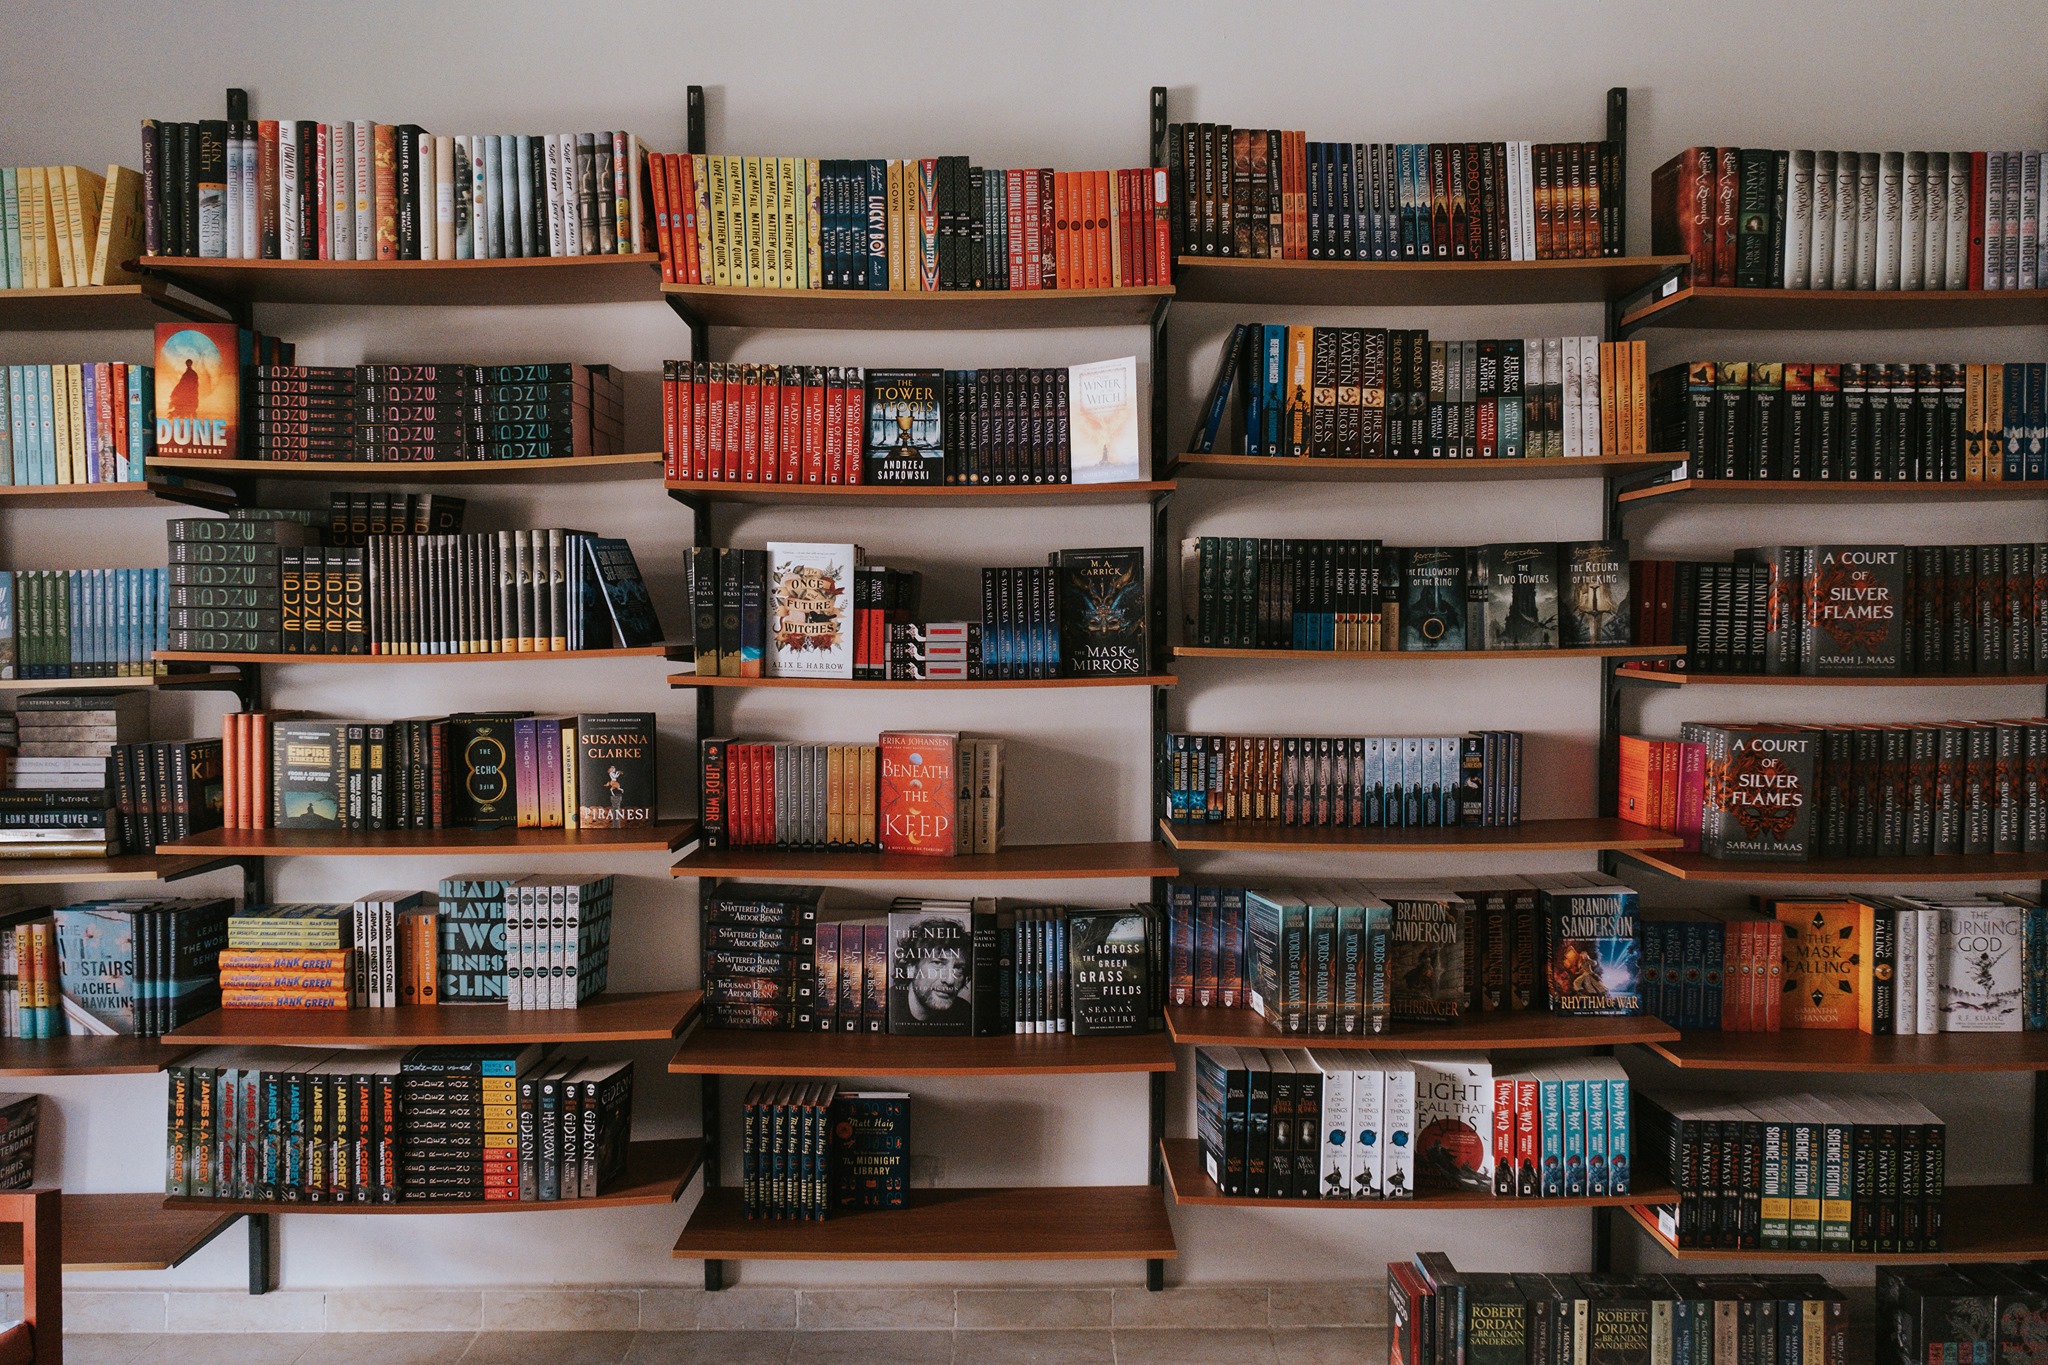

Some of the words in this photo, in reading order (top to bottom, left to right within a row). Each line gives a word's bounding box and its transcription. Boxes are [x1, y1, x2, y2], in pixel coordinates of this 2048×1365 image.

[335, 127, 343, 153] JUDY
[713, 160, 721, 176] LOVE
[335, 156, 344, 195] BLUME
[1990, 156, 2001, 194] CHARLIE
[869, 196, 885, 229] LUCKY
[1989, 196, 2000, 221] JANE
[718, 210, 726, 245] MATTHEW
[869, 233, 886, 258] BOY
[716, 246, 726, 267] QUICK
[1988, 236, 2000, 274] ANDERS
[1317, 334, 1329, 387] MARTIN
[897, 379, 913, 387] THE
[875, 387, 934, 401] TOWER
[55, 379, 65, 423] NICHOLAS
[888, 401, 933, 413] FOOLS
[1314, 409, 1323, 443] BLOOD
[1324, 409, 1333, 430] FIRE
[156, 418, 227, 446] DUNE
[883, 461, 924, 470] ANDRZEJ
[877, 471, 929, 480] SAPKOWSKI
[1822, 553, 1835, 565] A
[1841, 552, 1898, 565] COURT
[1080, 567, 1122, 576] CARRICK
[1405, 568, 1416, 576] THE
[1417, 567, 1460, 576] FELLOWSHIP
[1518, 564, 1529, 572] THE
[1570, 564, 1583, 572] THE
[1585, 562, 1619, 572] RETURN
[1434, 577, 1452, 586] RING
[1497, 574, 1516, 584] TWO
[1518, 574, 1549, 584] TOWERS
[1596, 574, 1617, 584] KING
[1851, 572, 1867, 581] OF
[792, 579, 823, 589] ONCE
[1700, 581, 1713, 616] NINTH
[1830, 588, 1888, 601] SILVER
[787, 600, 831, 610] FUTURE
[1824, 606, 1893, 619] FLAMES
[785, 623, 834, 633] WITCHES
[1697, 620, 1711, 655] HOUSE
[1086, 645, 1127, 658] MASK
[1072, 658, 1140, 672] MIRRORS
[1819, 656, 1854, 664] SARAH
[1866, 656, 1896, 664] MAAS
[581, 734, 648, 745] SUSANNA
[882, 737, 905, 745] ERIKA
[908, 738, 948, 746] JOHANSEN
[1732, 739, 1746, 751] A
[1751, 739, 1809, 753] COURT
[588, 748, 642, 759] CLARKE
[475, 765, 497, 775] ECHO
[883, 758, 948, 778] BENEATH
[1761, 759, 1778, 768] OF
[705, 764, 720, 794] JADE
[1738, 774, 1799, 788] SILVER
[903, 790, 928, 802] THE
[1732, 792, 1803, 806] FLAMES
[584, 808, 650, 820] PIRANESI
[705, 796, 720, 821] WAR
[5, 815, 25, 824] LONG
[30, 815, 60, 824] BRIGHT
[63, 815, 89, 824] RIVER
[886, 814, 948, 837] KEEP
[1727, 841, 1761, 850] SARAH
[1773, 843, 1803, 851] MAAS
[720, 903, 759, 913] SHATTERED
[760, 905, 783, 914] REALM
[1572, 898, 1621, 916] BRANDON
[734, 913, 759, 922] ARDOR
[760, 914, 779, 923] BENN
[1971, 911, 1989, 919] THE
[894, 929, 919, 939] THE
[924, 927, 960, 939] NEIL
[1561, 916, 1633, 937] SANDERSON
[1939, 921, 2017, 936] BURNING
[1806, 934, 1831, 944] THE
[1958, 937, 2002, 952] GOD
[894, 947, 960, 959] GAIMAN
[1096, 944, 1140, 954] ACROSS
[1289, 932, 1301, 962] WORDS
[1798, 945, 1841, 958] MASK
[274, 958, 299, 968] HANK
[302, 959, 332, 969] GREEN
[1098, 959, 1128, 968] GREEN
[1785, 961, 1851, 974] FALLING
[895, 967, 957, 980] READER
[1079, 971, 1123, 983] GRASS
[73, 983, 119, 995] RACHEL
[385, 975, 393, 993] CLINE
[1288, 970, 1300, 1010] RADIANCE
[1103, 986, 1141, 996] FIELDS
[82, 996, 136, 1009] HAWKINS
[1561, 996, 1605, 1009] RHYTHM
[1616, 997, 1639, 1009] WAR
[1088, 1005, 1132, 1014] SEANAN
[1085, 1015, 1137, 1024] McGUIRE
[1437, 1072, 1456, 1081] THE
[1417, 1083, 1482, 1101] LIGHT
[1614, 1083, 1625, 1111] BLOODY
[313, 1086, 323, 1122] JAMES
[1433, 1102, 1449, 1113] ALL
[1454, 1103, 1487, 1114] THAT
[873, 1118, 894, 1131] Haig
[1419, 1116, 1477, 1133] FALLS
[1612, 1111, 1626, 1130] ROSE
[543, 1112, 555, 1162] HARROW
[584, 1110, 596, 1161] GIDEON
[1766, 1126, 1780, 1161] SCIENCE
[856, 1156, 900, 1165] MIDNIGHT
[313, 1149, 322, 1188] COREY
[853, 1166, 890, 1175] LIBRARY
[1925, 1150, 1934, 1195] FANTASY
[1765, 1163, 1779, 1195] FICTION
[1472, 1306, 1525, 1318] ROBERT
[1471, 1319, 1525, 1330] JORDAN
[1470, 1337, 1524, 1345] SANDERSON
